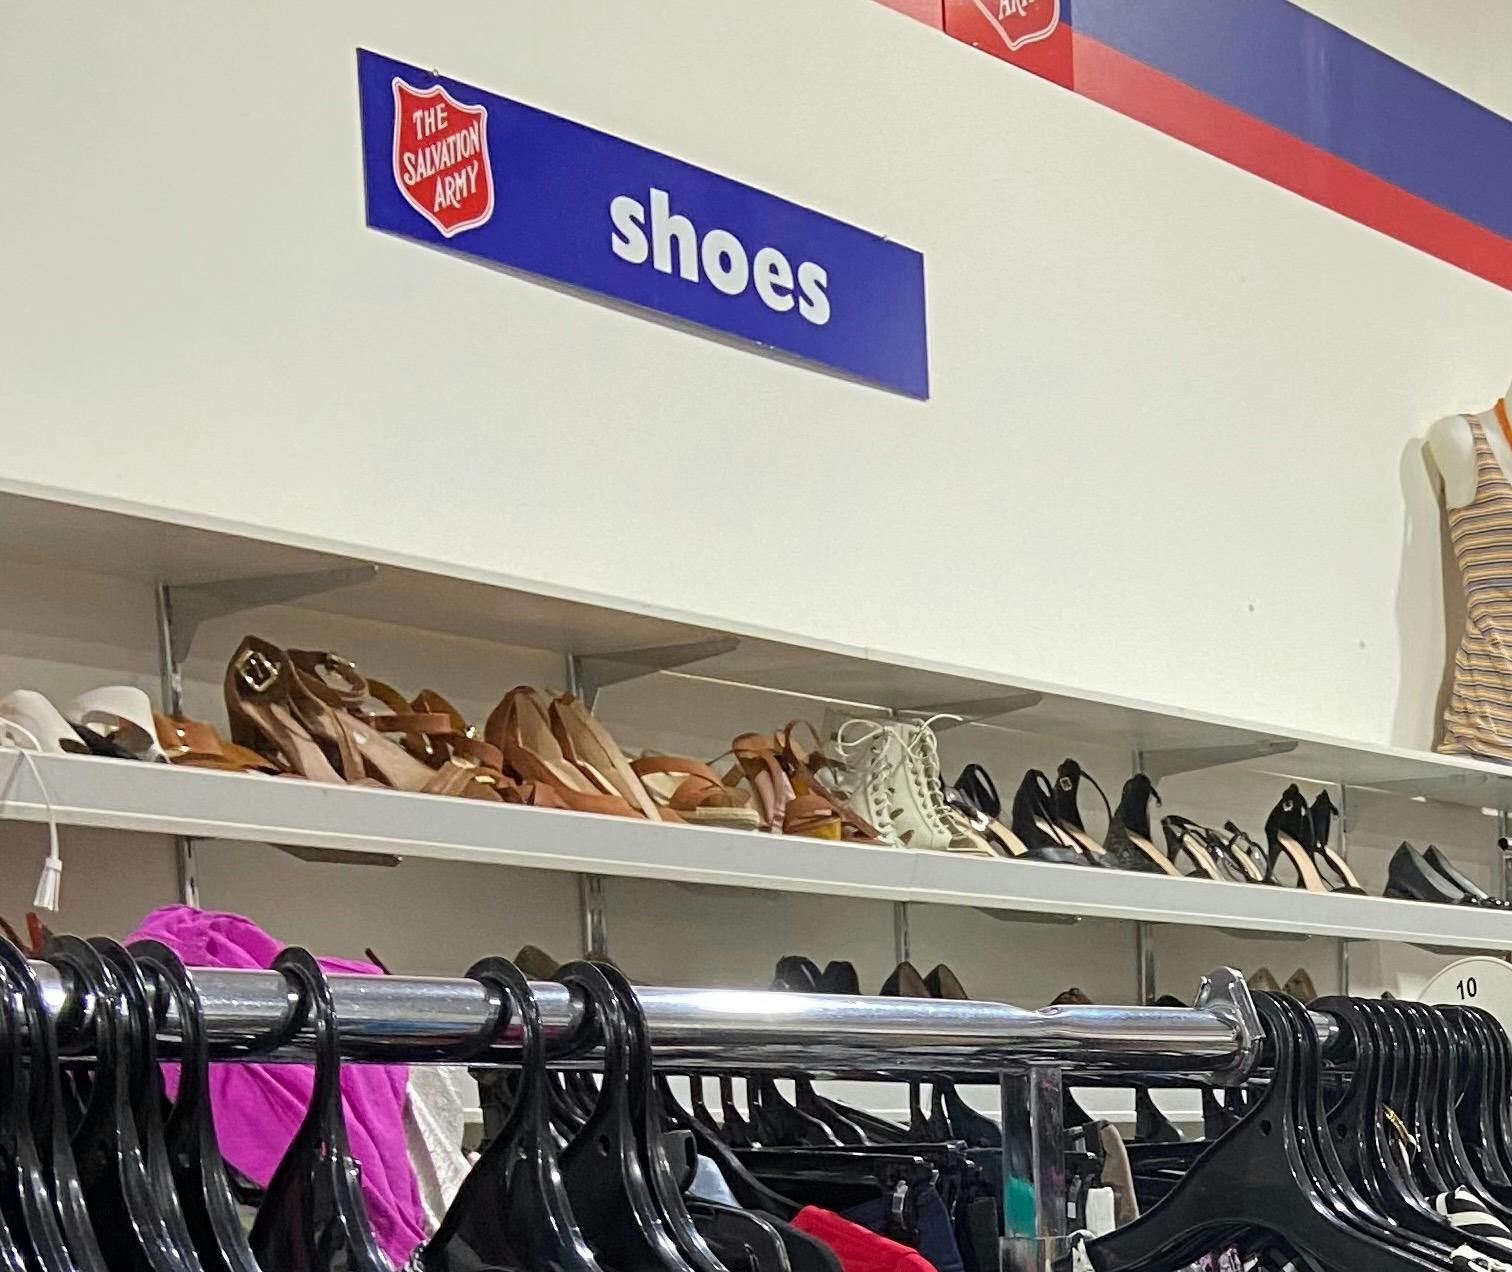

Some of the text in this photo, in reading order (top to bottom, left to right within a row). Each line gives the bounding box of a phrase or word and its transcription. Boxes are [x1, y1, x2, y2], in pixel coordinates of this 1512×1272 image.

[413, 103, 448, 140] THE
[403, 120, 480, 186] SALVATION
[434, 159, 479, 213] ARMY
[610, 187, 831, 325] shoes
[1456, 976, 1477, 1000] 10
